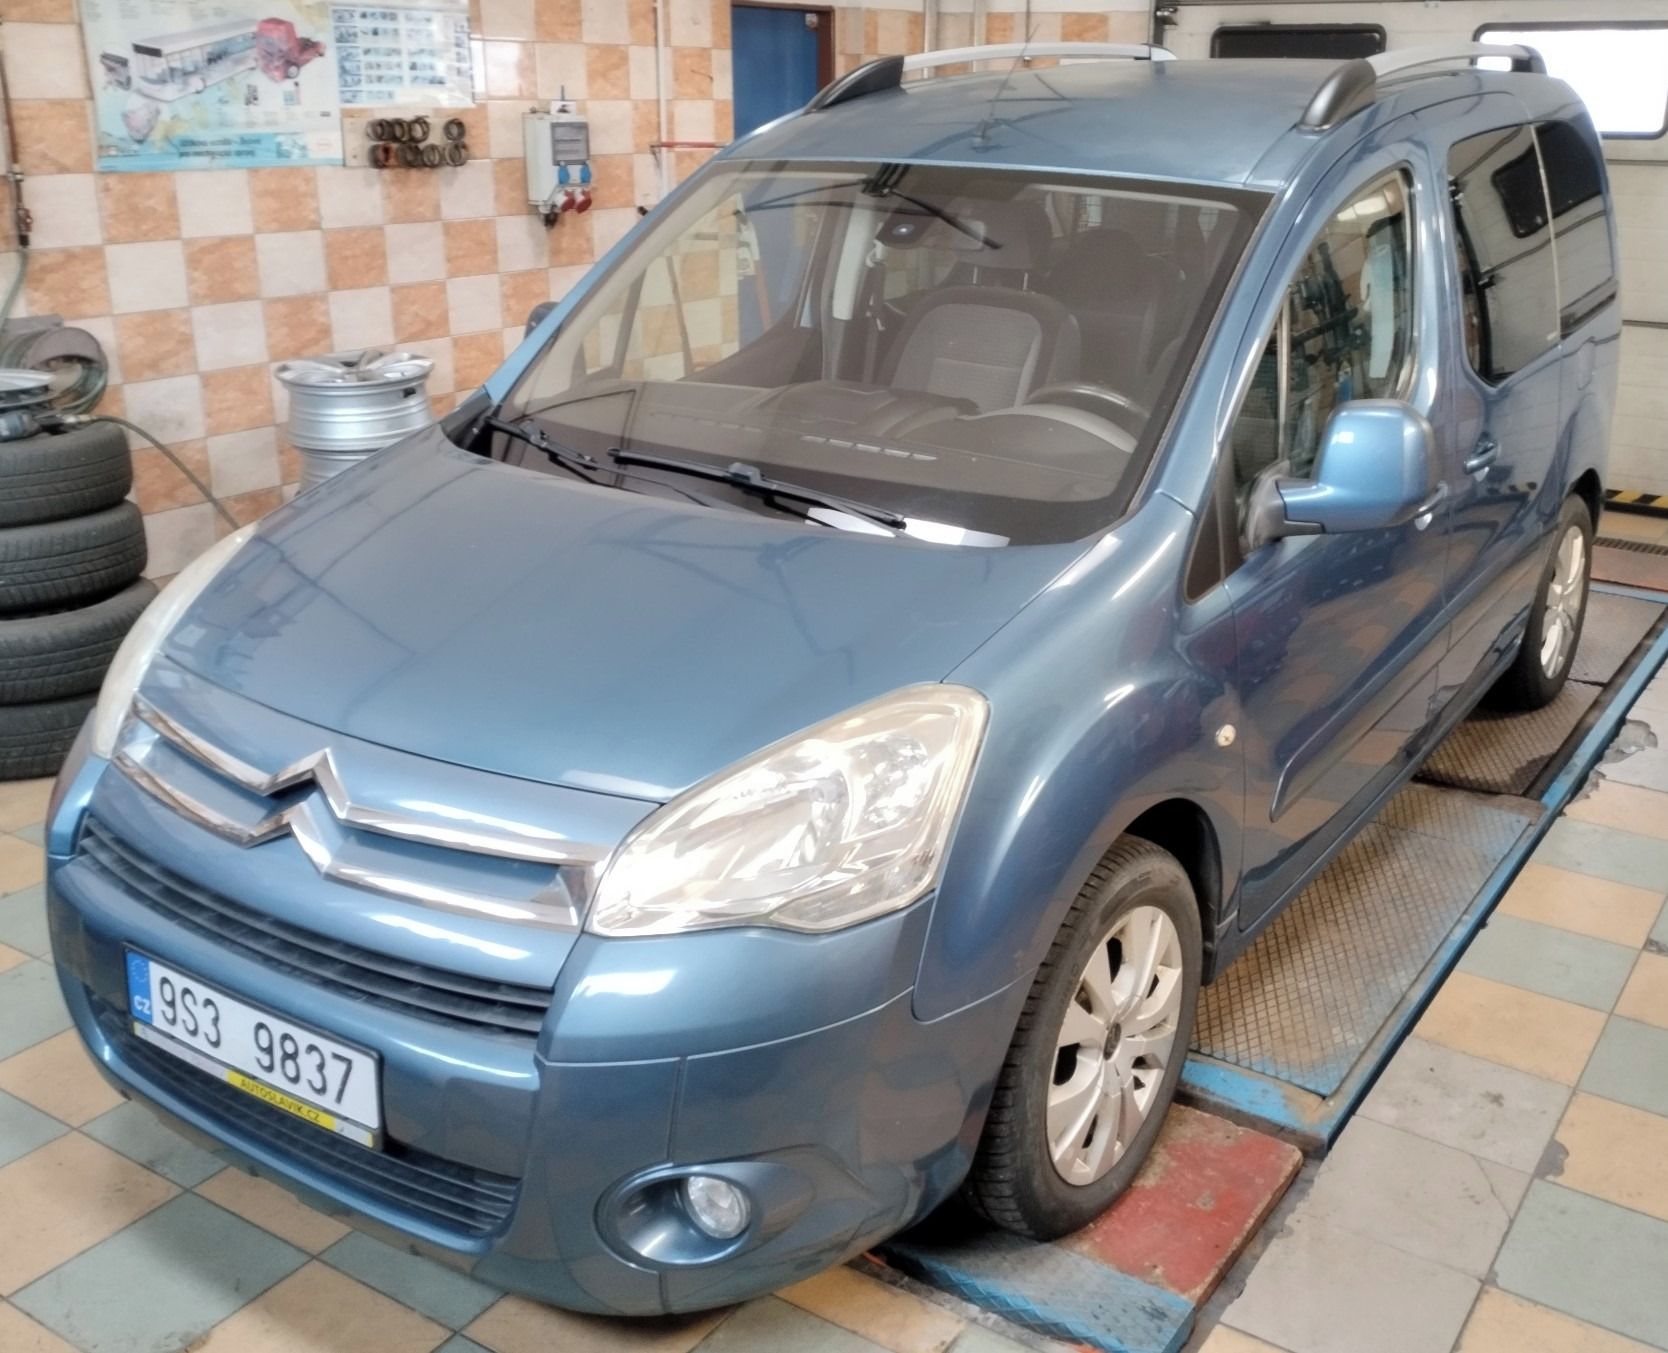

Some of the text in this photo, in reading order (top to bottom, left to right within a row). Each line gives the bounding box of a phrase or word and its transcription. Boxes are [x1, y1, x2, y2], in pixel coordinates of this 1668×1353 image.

[133, 995, 150, 1015] CZ
[159, 976, 353, 1105] 9S3 9837
